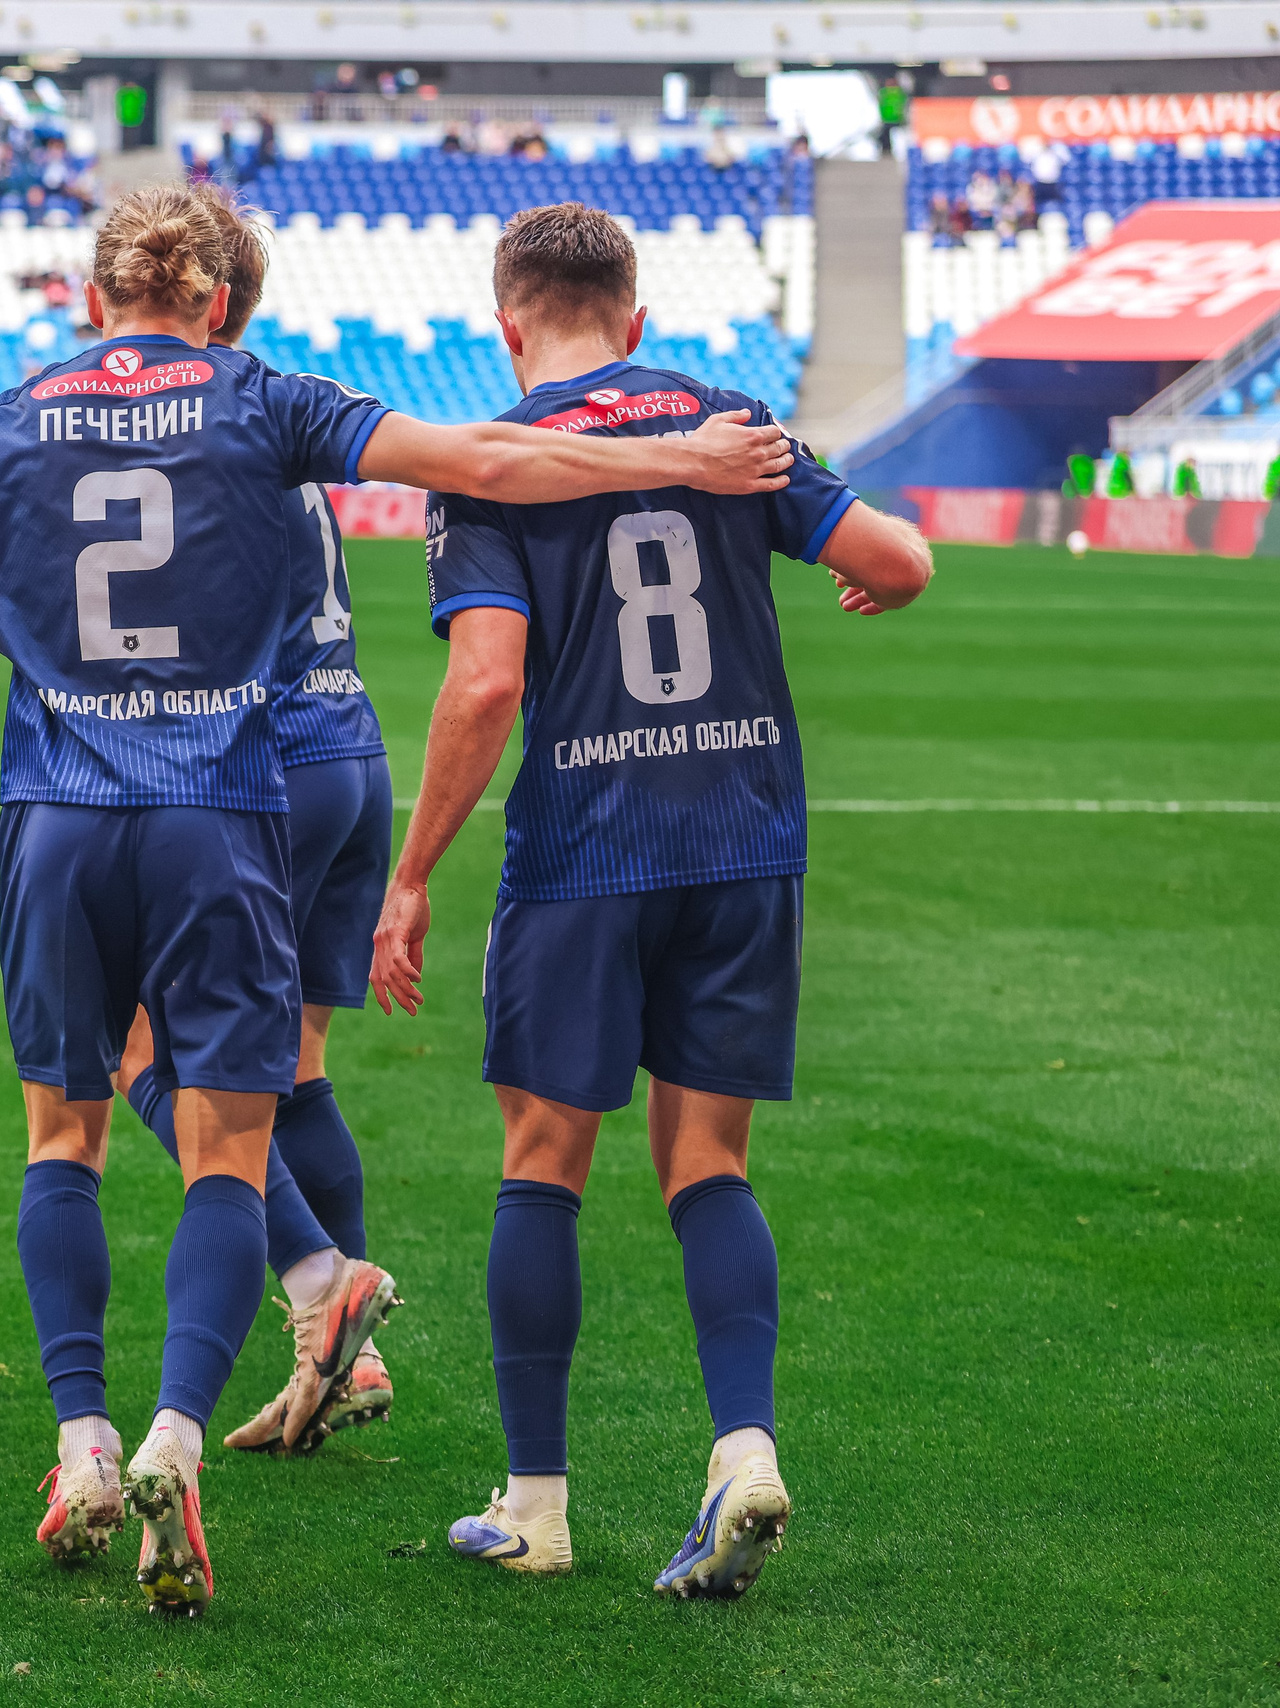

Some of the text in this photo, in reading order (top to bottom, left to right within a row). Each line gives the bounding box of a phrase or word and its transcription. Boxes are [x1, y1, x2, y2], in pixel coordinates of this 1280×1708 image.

[41, 370, 201, 397] СОЛИДАРНОСТЬ
[157, 362, 194, 375] БАНК
[643, 393, 680, 403] БАНК
[39, 396, 203, 442] ПЕЧЕНИН
[551, 400, 691, 434] ОЛИДАРНОСТЬ
[73, 467, 180, 661] 2
[607, 510, 712, 705] 8
[163, 679, 267, 716] ОБЛАСТЬ
[554, 716, 781, 770] САМАРСКАЯ ОБЛАСТЬ
